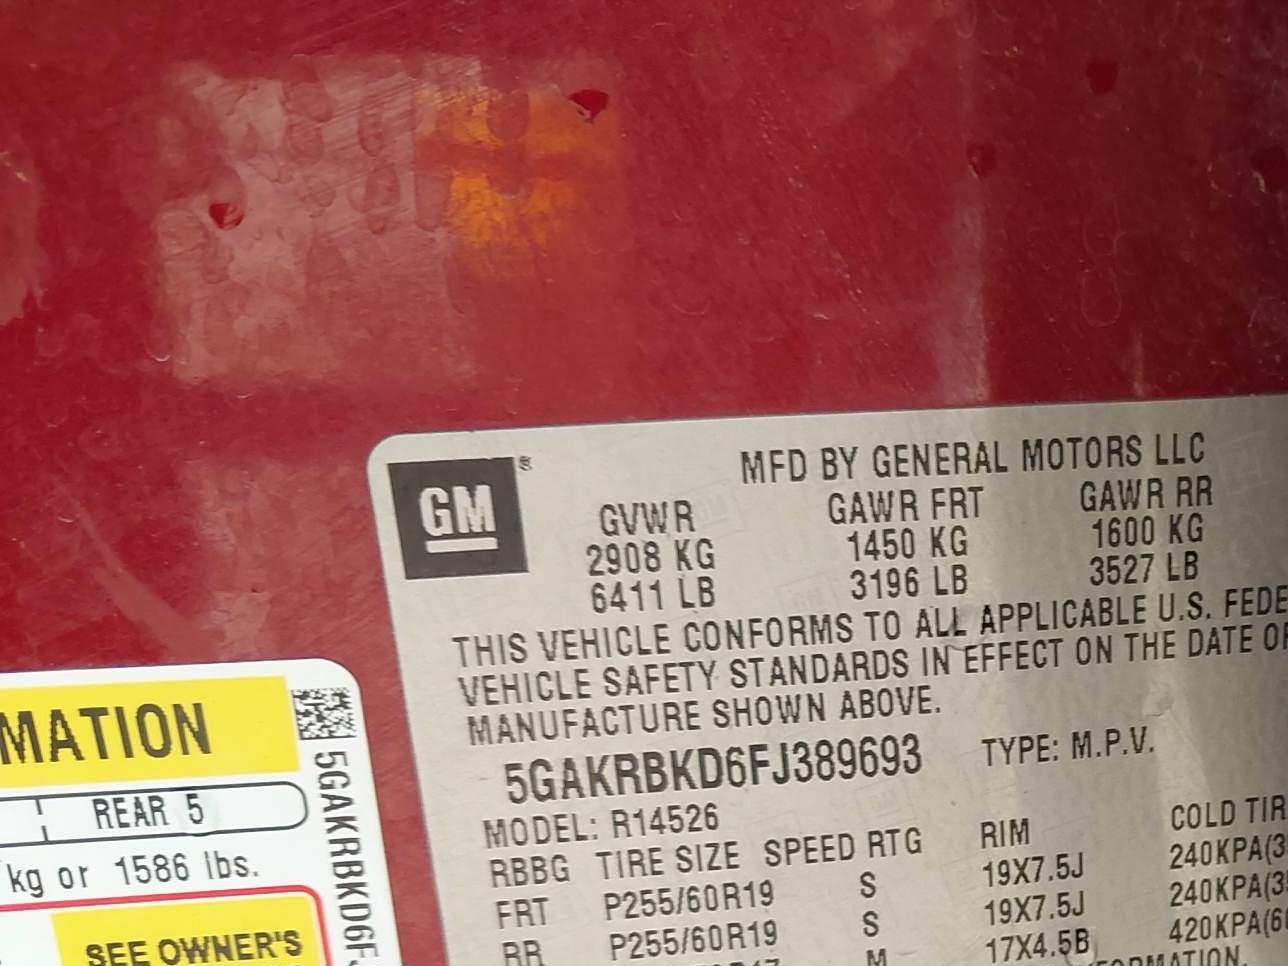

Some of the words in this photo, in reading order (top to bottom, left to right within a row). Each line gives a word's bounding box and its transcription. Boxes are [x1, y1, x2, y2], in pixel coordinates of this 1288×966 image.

[741, 449, 807, 484] MFD
[821, 447, 858, 480] BY
[873, 441, 1008, 477] GENERAL
[1023, 435, 1141, 471] MOTORS
[1156, 432, 1204, 465] LLC
[420, 485, 495, 536] GM
[828, 489, 919, 524] GAWR
[932, 486, 984, 520] FRT
[1081, 478, 1164, 512] GAWR
[1177, 475, 1212, 507] RR
[600, 500, 695, 536] GVWR
[1092, 516, 1154, 548] 1600
[1170, 513, 1203, 544] KG
[587, 541, 661, 576] 2908
[675, 538, 714, 571] KG
[848, 528, 915, 561] 1450
[931, 525, 967, 557] KG
[851, 567, 918, 600] 3196
[934, 564, 967, 595] LB
[1090, 554, 1154, 586] 3527
[1168, 551, 1198, 581] LB
[591, 580, 663, 613] 6411
[679, 576, 714, 608] LB
[452, 633, 527, 667] THIS
[537, 624, 670, 661] VEHICLE
[684, 613, 853, 652] CONFORMS
[864, 611, 900, 641] TO
[916, 607, 966, 638] ALL
[981, 595, 1146, 634] APPLICABLE
[1159, 591, 1211, 622] U.S.
[458, 669, 591, 706] VEHICLE
[603, 660, 716, 696] SAFETY
[730, 649, 908, 688] STANDARDS
[922, 646, 950, 677] IN
[963, 638, 1064, 673] EFFECT
[1076, 635, 1112, 665] ON
[1124, 630, 1175, 661] THE
[1189, 624, 1253, 657] DATE
[0, 703, 211, 764] MATION
[467, 701, 701, 745] MANUFACTURE
[713, 693, 825, 728] SHOWN
[840, 685, 940, 720] ABOVE.
[982, 734, 1058, 766] TYPE:
[1072, 726, 1153, 759] M.P.V.
[504, 733, 922, 804] 5GAKRBKD6FJ389693
[92, 795, 168, 829] REAR
[186, 793, 203, 824] 5
[483, 814, 597, 848] MODEL:
[611, 803, 718, 838] R14526
[1172, 800, 1236, 830] COLD
[981, 818, 1029, 848] RIM
[7, 864, 44, 898] kg
[58, 866, 87, 889] or
[115, 853, 189, 885] 1586
[204, 851, 257, 879] lbs.
[490, 855, 569, 888] RBBG
[595, 848, 664, 879] TIRE
[676, 841, 739, 873] SIZE
[764, 833, 855, 866] SPEED
[868, 827, 921, 858] RTG
[983, 852, 1083, 887] 19X7.5J
[496, 898, 548, 929] FRT
[604, 880, 774, 920] P255/60R19
[860, 872, 876, 898] S
[985, 890, 1084, 925] 19X7.5J
[158, 930, 302, 965] OWNER'S
[610, 920, 777, 960] P255/60R19
[863, 911, 879, 937] S
[986, 928, 1089, 963] 17X4.5B
